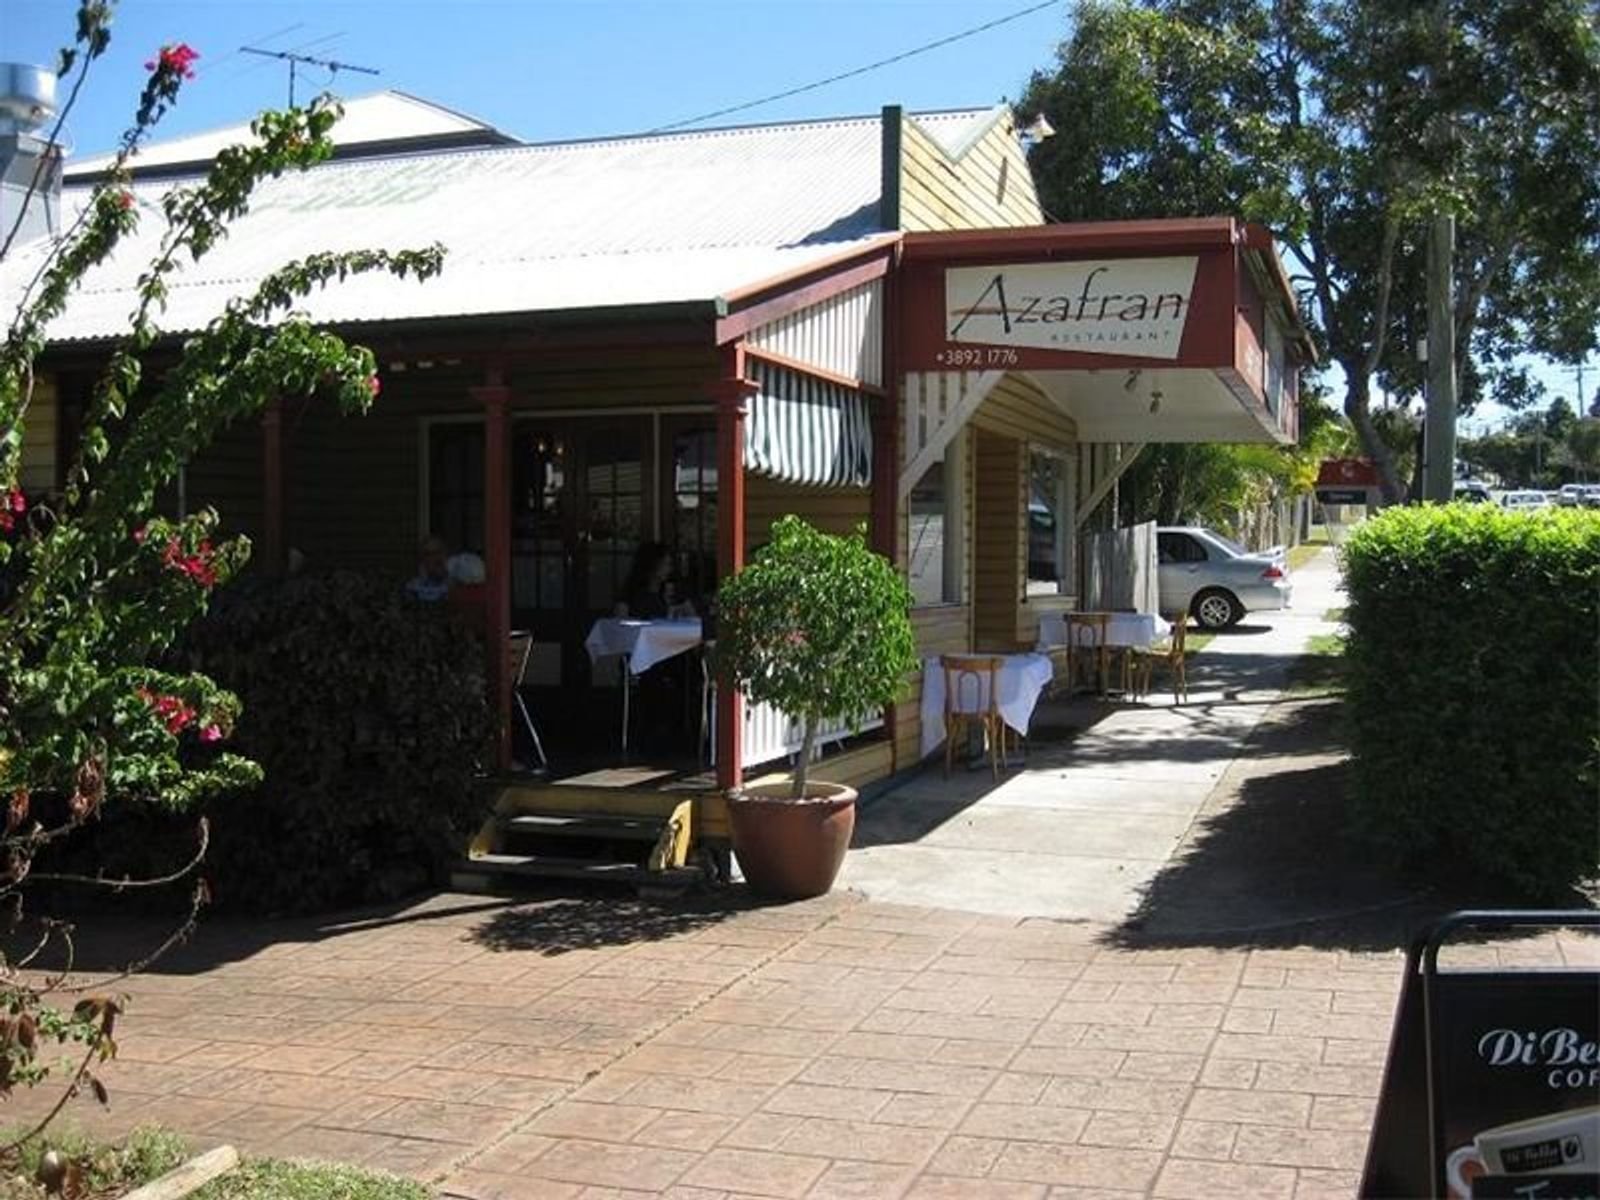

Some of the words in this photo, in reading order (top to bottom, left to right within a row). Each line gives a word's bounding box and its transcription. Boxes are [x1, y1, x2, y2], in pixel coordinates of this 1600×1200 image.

[951, 267, 1185, 336] Azafran
[1050, 330, 1170, 343] RESTAURANT
[945, 349, 981, 365] 3892
[987, 348, 1018, 365] 1776
[1478, 1029, 1537, 1065] Di
[1540, 1028, 1600, 1065] Be
